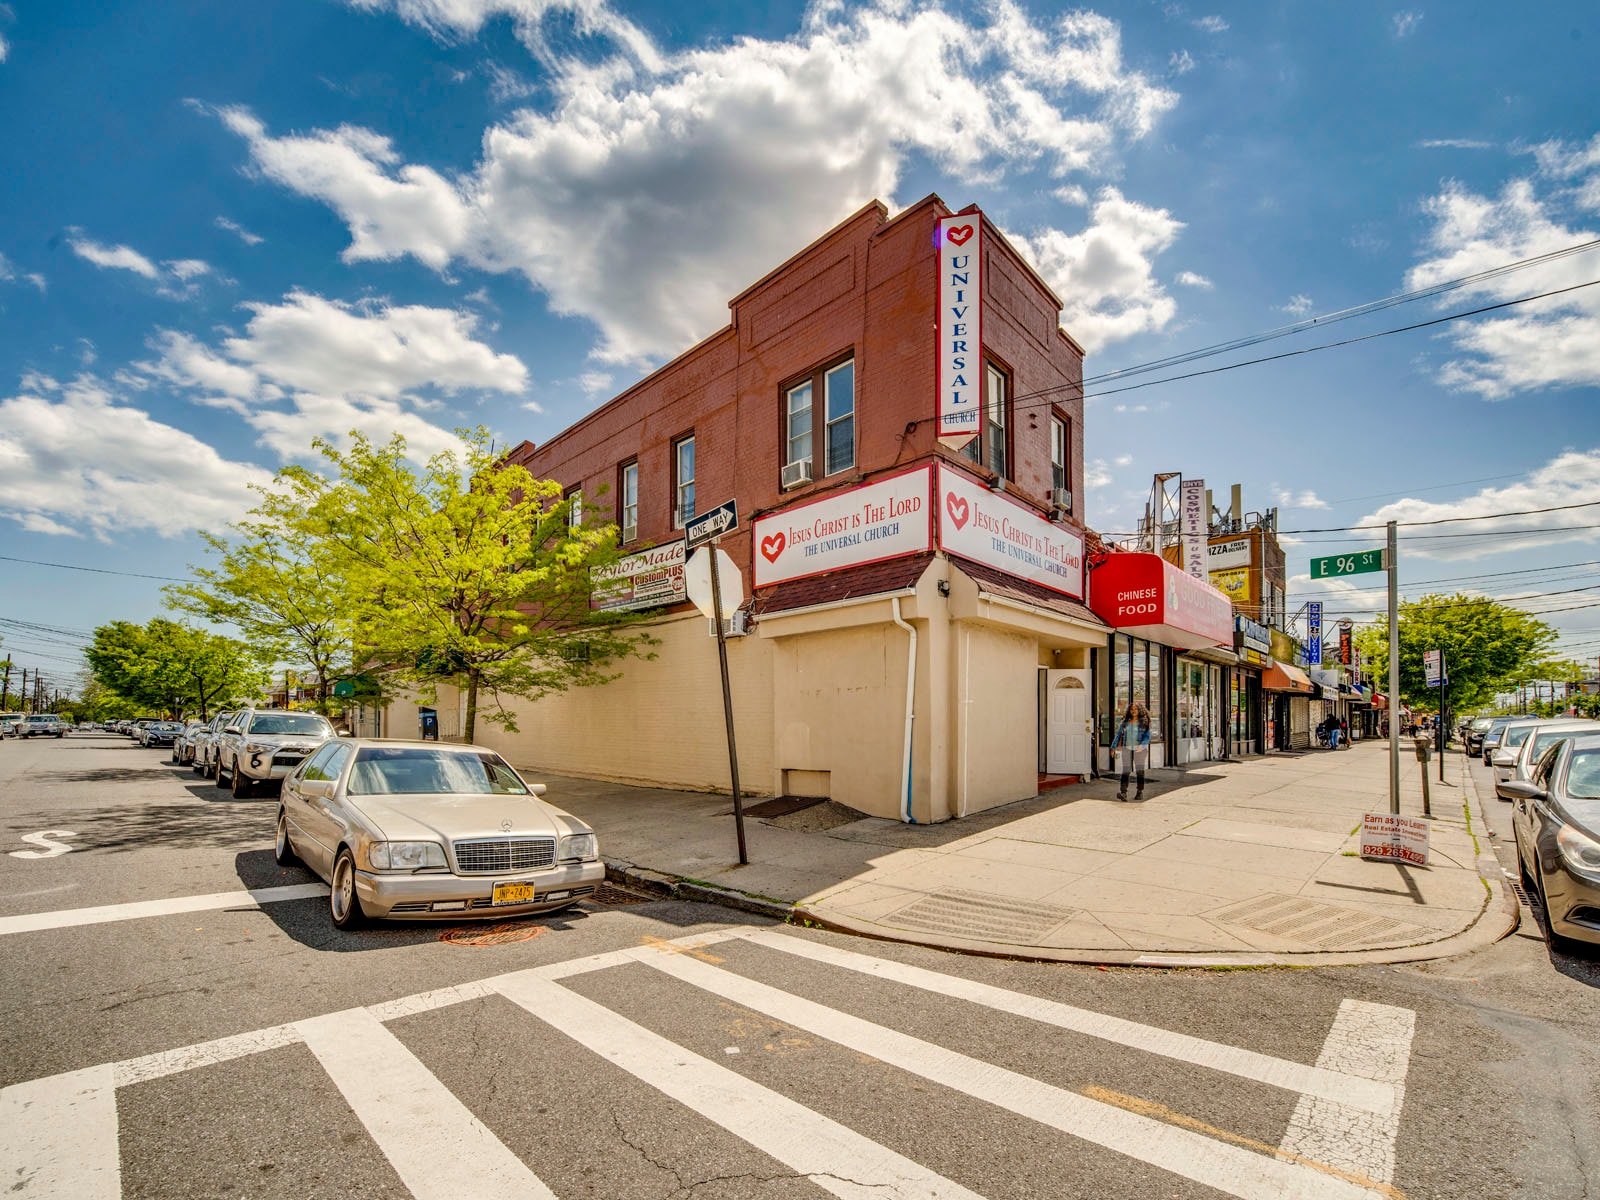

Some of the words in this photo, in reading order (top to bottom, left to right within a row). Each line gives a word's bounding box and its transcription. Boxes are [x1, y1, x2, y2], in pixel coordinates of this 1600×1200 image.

[951, 255, 970, 404] UNIVERSAL
[943, 411, 976, 425] CHURCH
[692, 522, 707, 538] ONE
[712, 512, 729, 528] WAY
[1186, 488, 1200, 544] COSMETICS
[804, 543, 818, 557] THE
[820, 532, 861, 553] UNIVERSAL
[864, 522, 899, 542] CHURCH
[1207, 545, 1228, 556] IZZA
[638, 543, 684, 570] Made
[991, 537, 1006, 554] THE
[1008, 543, 1042, 569] UNIVERSAL
[1044, 559, 1067, 578] CHURCH
[1189, 553, 1203, 582] SALO
[1320, 560, 1329, 575] E
[1336, 556, 1355, 573] 96
[1362, 554, 1373, 564] St
[634, 565, 684, 586] CustomPLUS
[1117, 588, 1157, 602] CHINESE
[1118, 603, 1157, 616] FOOD
[1341, 633, 1350, 664] PIZZA
[1364, 813, 1383, 823] Earn
[1396, 818, 1408, 827] you
[1380, 825, 1401, 833] Estate
[8, 830, 77, 859] S
[514, 886, 531, 898] 2475
